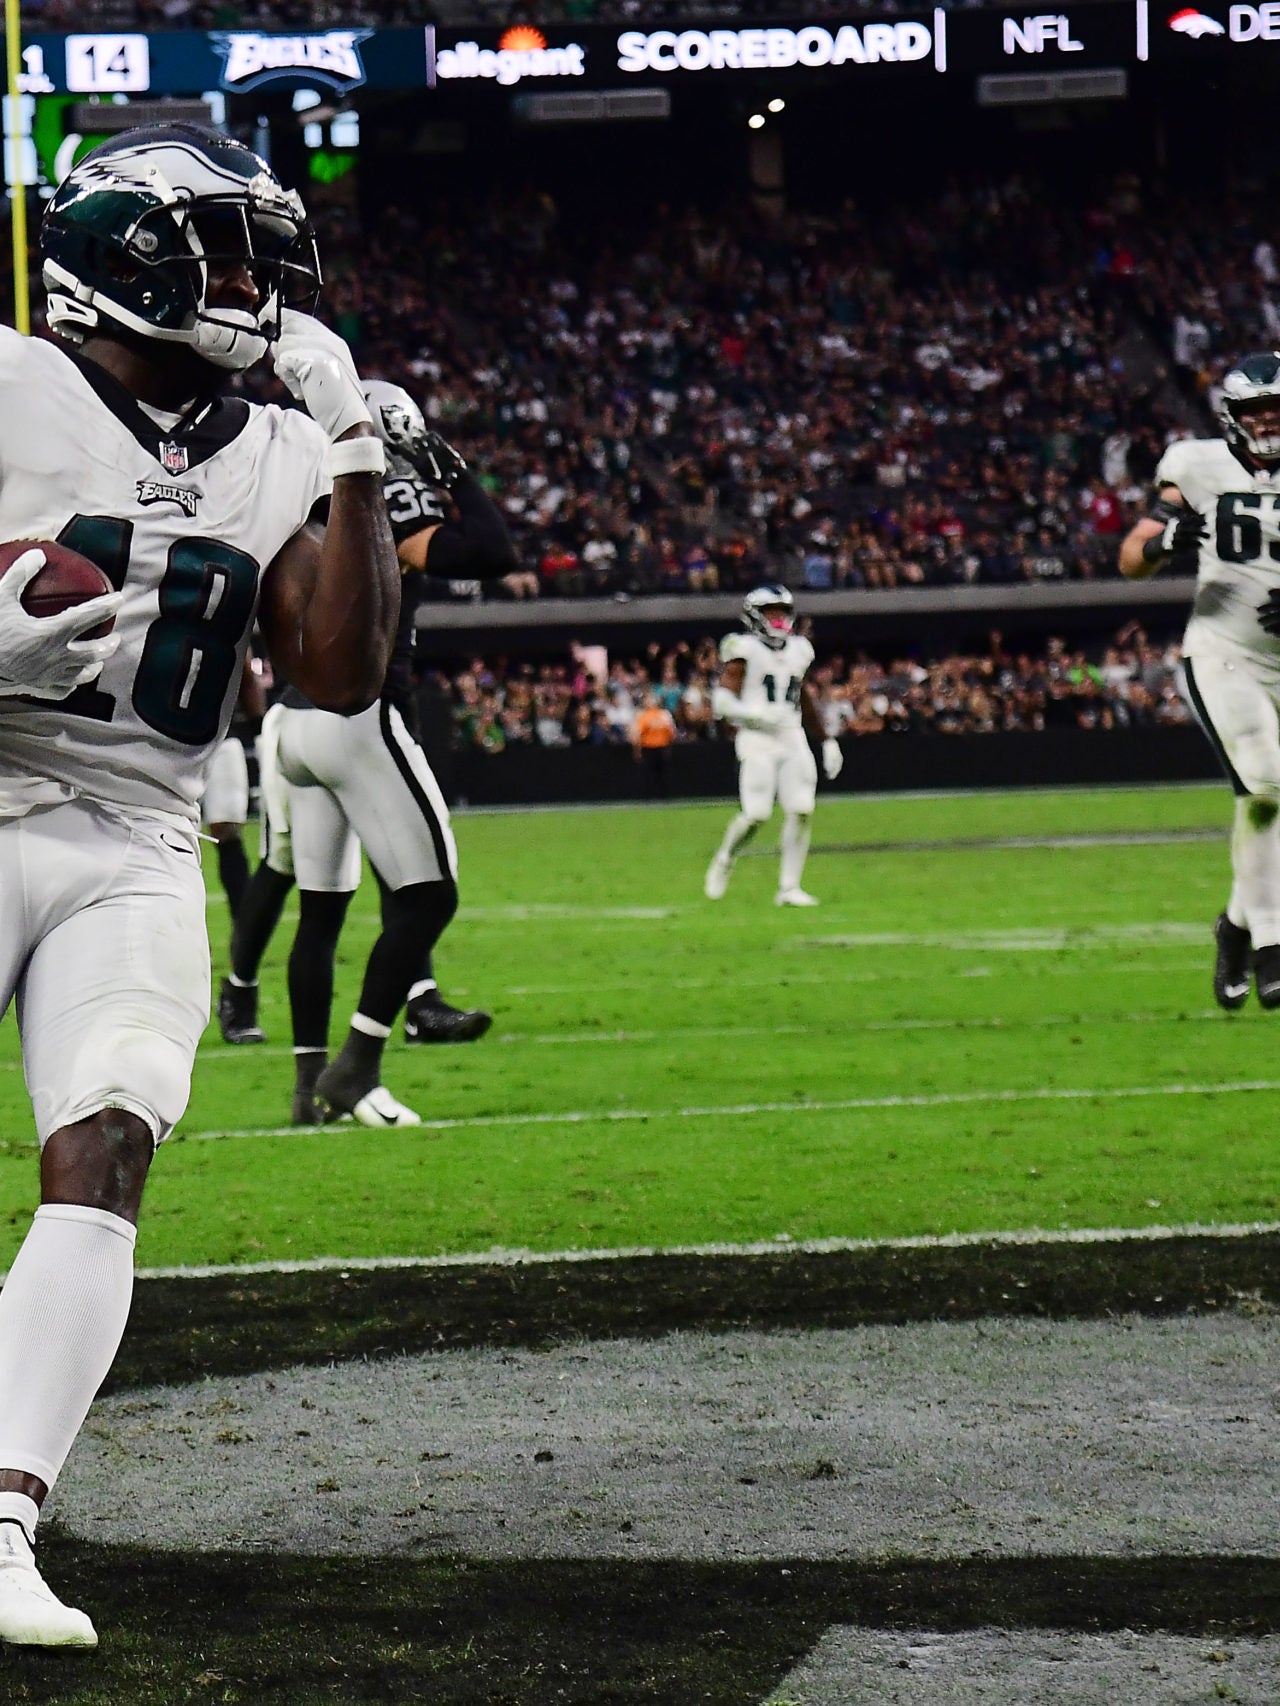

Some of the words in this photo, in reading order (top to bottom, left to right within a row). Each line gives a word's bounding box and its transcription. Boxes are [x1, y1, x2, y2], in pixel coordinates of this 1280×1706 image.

[1002, 14, 1084, 55] NFL
[1228, 2, 1280, 43] DE
[21, 44, 44, 75] 1
[85, 45, 131, 82] 14
[223, 30, 362, 82] EAGLES
[435, 41, 586, 86] allegiant
[616, 21, 932, 72] SCOREBOARD
[138, 482, 197, 515] EAGLES
